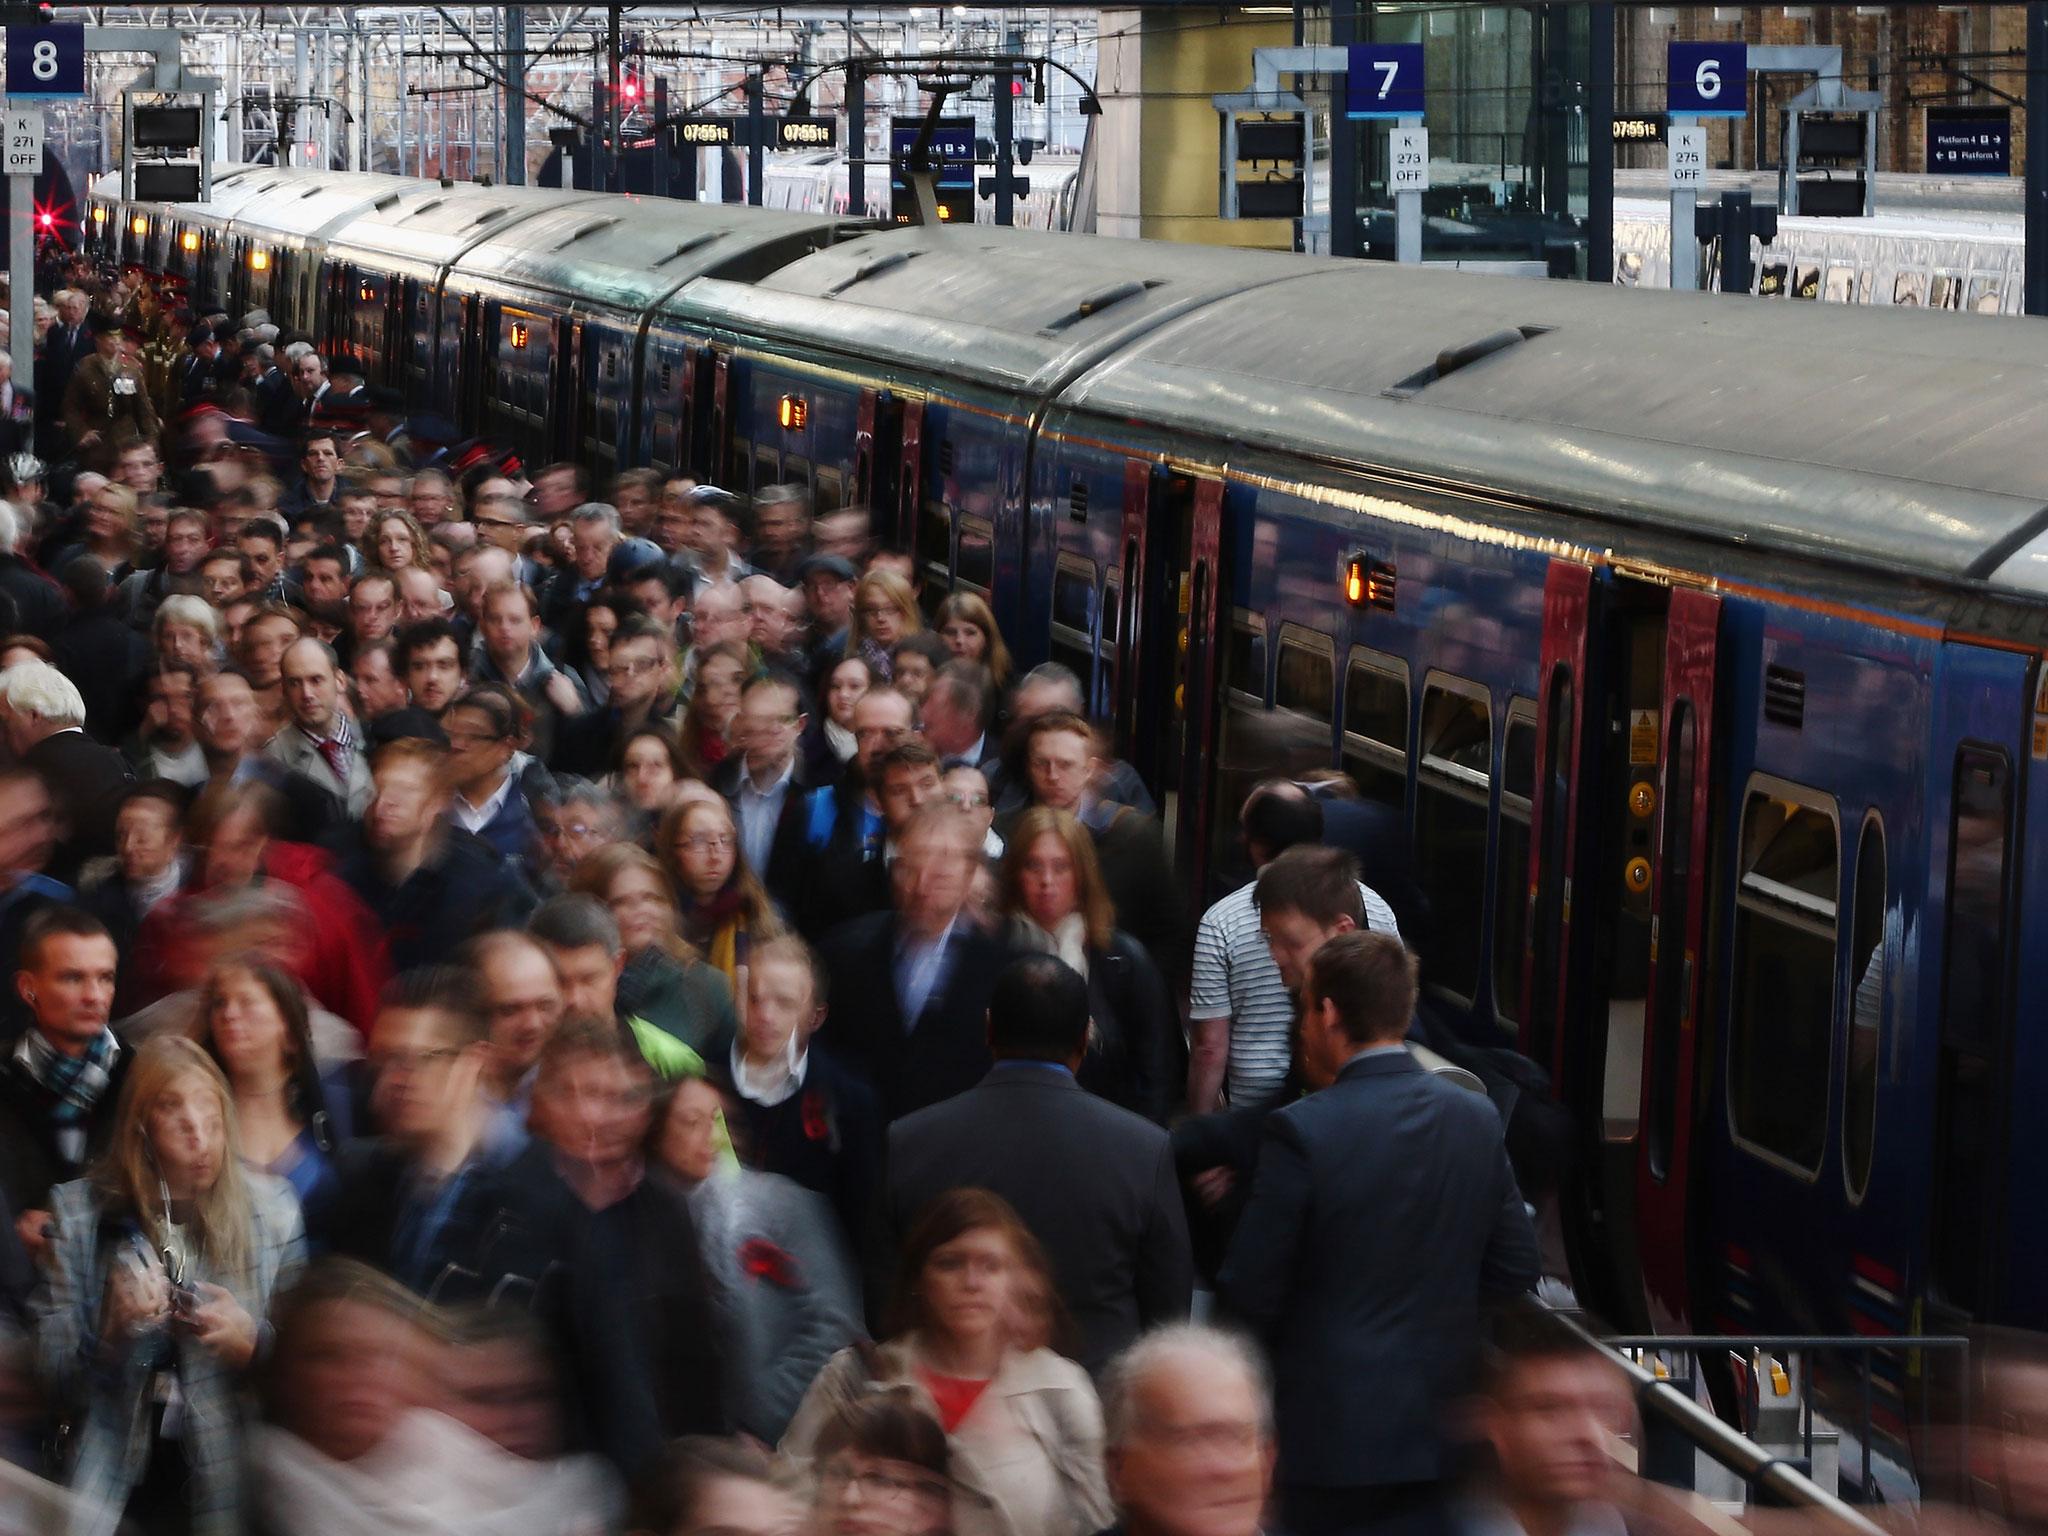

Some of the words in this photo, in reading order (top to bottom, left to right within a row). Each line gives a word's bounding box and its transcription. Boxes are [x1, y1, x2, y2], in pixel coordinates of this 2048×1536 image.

[32, 40, 58, 81] 8
[1373, 61, 1399, 100] 7
[1695, 59, 1721, 99] 6
[18, 118, 27, 130] K
[13, 136, 34, 147] 271
[1403, 135, 1412, 146] K
[1682, 135, 1691, 146] K
[1937, 136, 1969, 144] Platform
[1969, 136, 1976, 144] 4
[9, 153, 36, 165] OFF
[1397, 153, 1421, 164] 273
[1675, 151, 1699, 163] 275
[1961, 151, 1994, 160] Platform
[1995, 151, 2000, 160] 5
[1396, 170, 1422, 181] OFF
[1674, 168, 1700, 180] OFF
